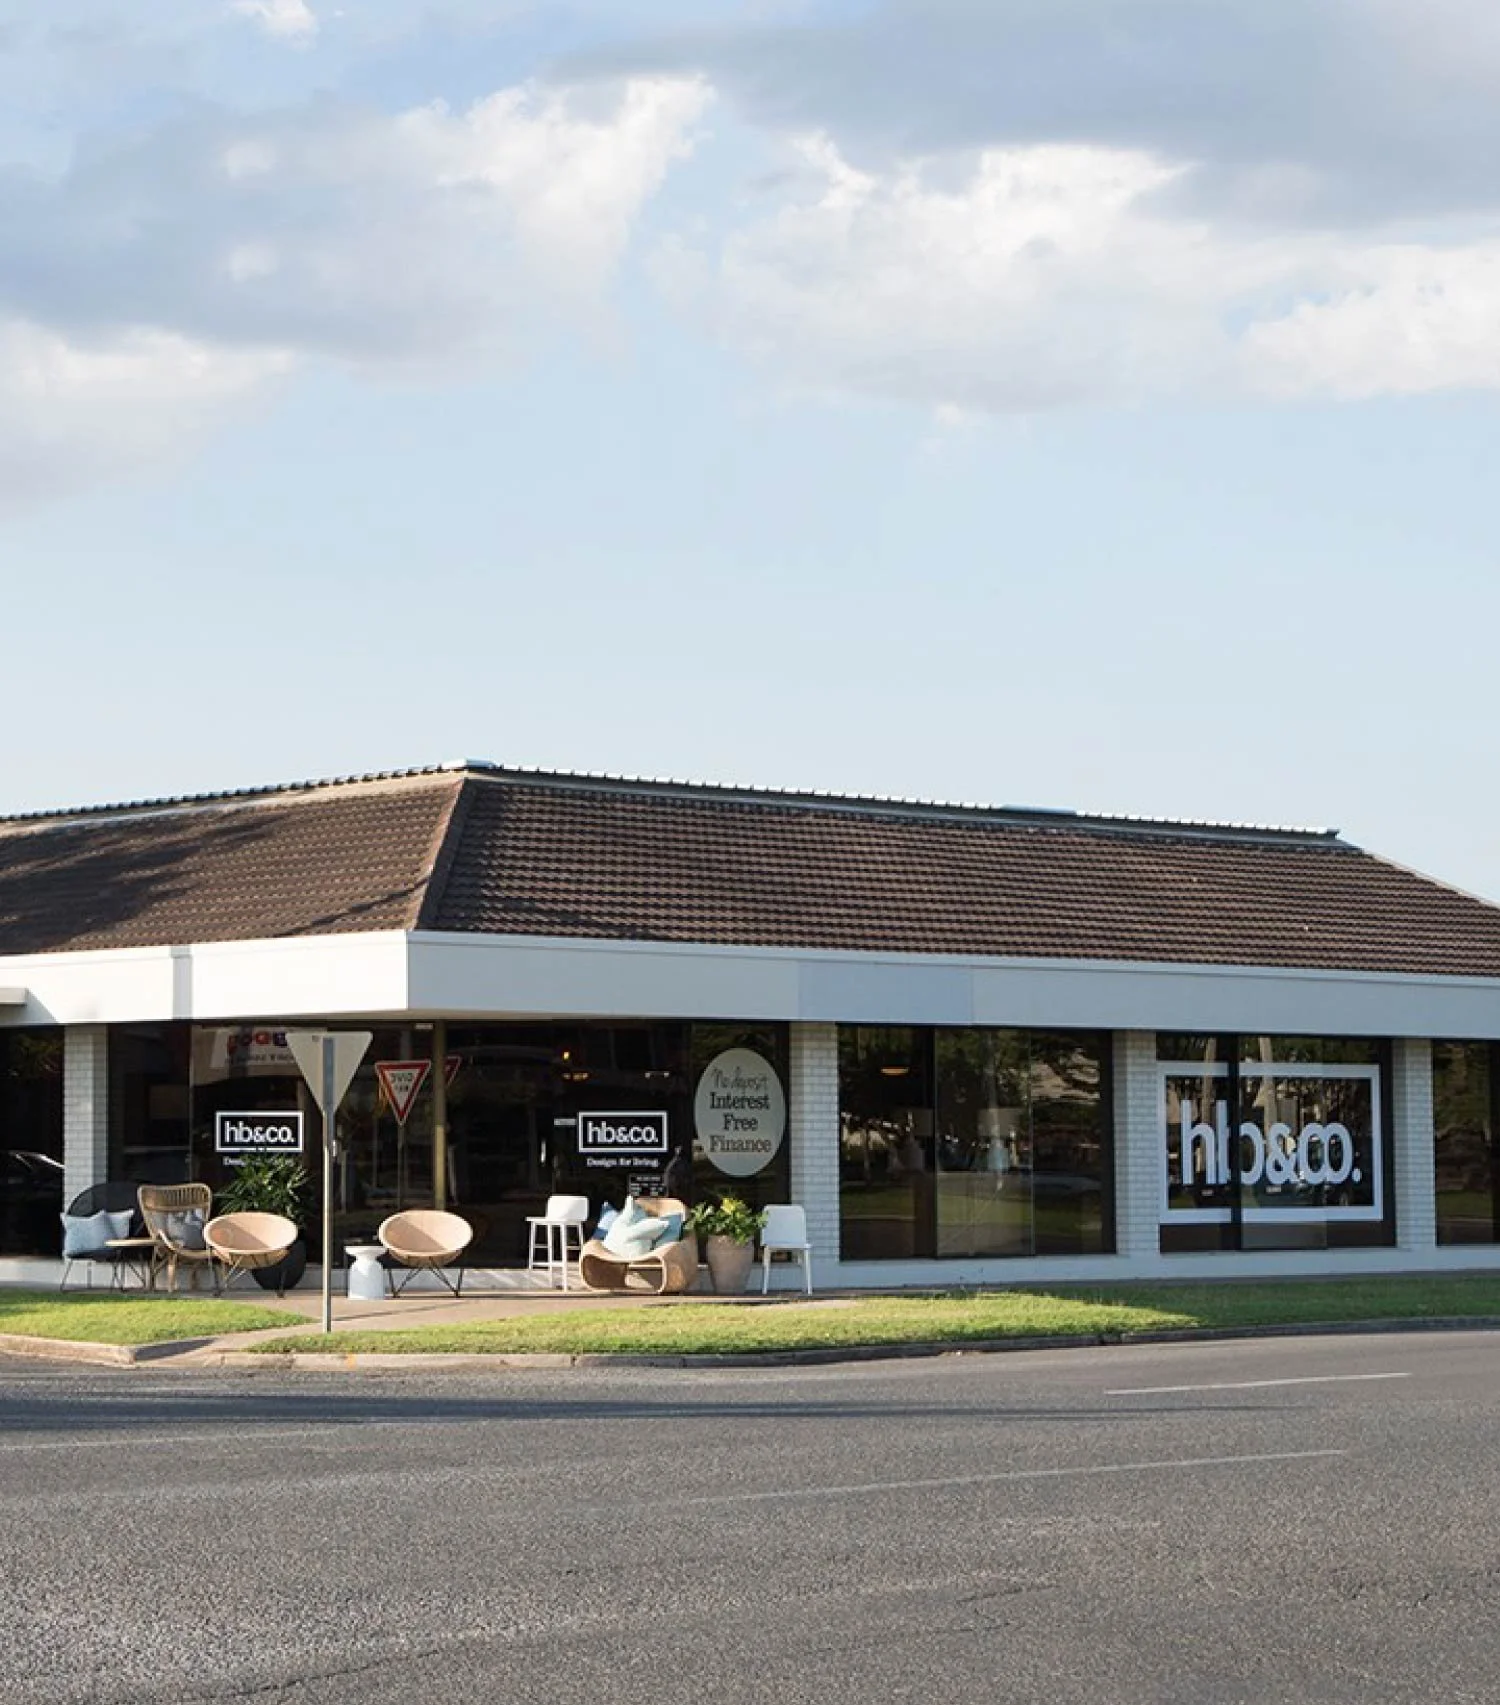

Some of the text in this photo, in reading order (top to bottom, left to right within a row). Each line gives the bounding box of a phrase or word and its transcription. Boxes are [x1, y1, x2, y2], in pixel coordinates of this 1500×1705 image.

[710, 1091, 770, 1110] Interest
[723, 1112, 758, 1131] Free
[224, 1120, 295, 1143] hb&co.
[587, 1120, 659, 1144] hb&co.
[709, 1135, 771, 1152] Finance
